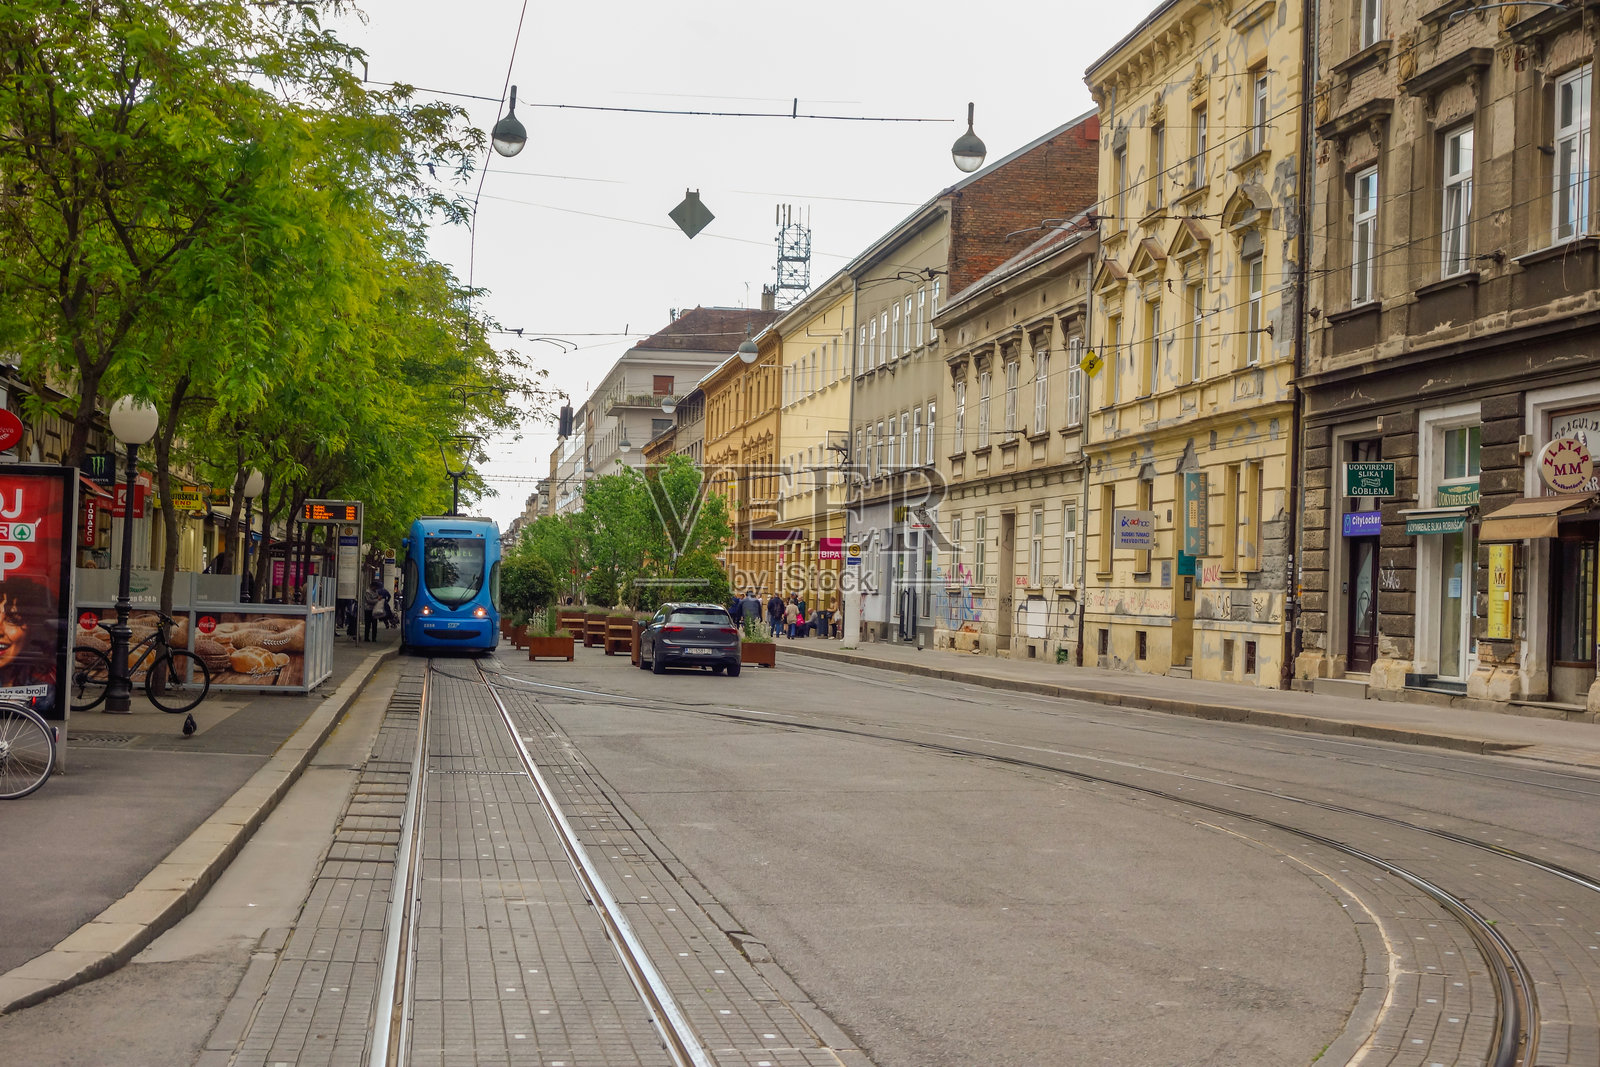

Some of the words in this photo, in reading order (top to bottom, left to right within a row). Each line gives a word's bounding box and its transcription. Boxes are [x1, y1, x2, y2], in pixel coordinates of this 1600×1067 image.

[1544, 440, 1589, 467] ZLATAR
[1358, 470, 1380, 478] SLIKA
[1380, 470, 1384, 478] I
[1553, 462, 1582, 476] MM
[1351, 486, 1389, 495] GOBLENA
[0, 488, 23, 519] J
[86, 502, 94, 542] TOBACCO
[1351, 515, 1381, 527] CityLocker
[821, 550, 841, 558] BIPA
[26, 686, 46, 696] broji!
